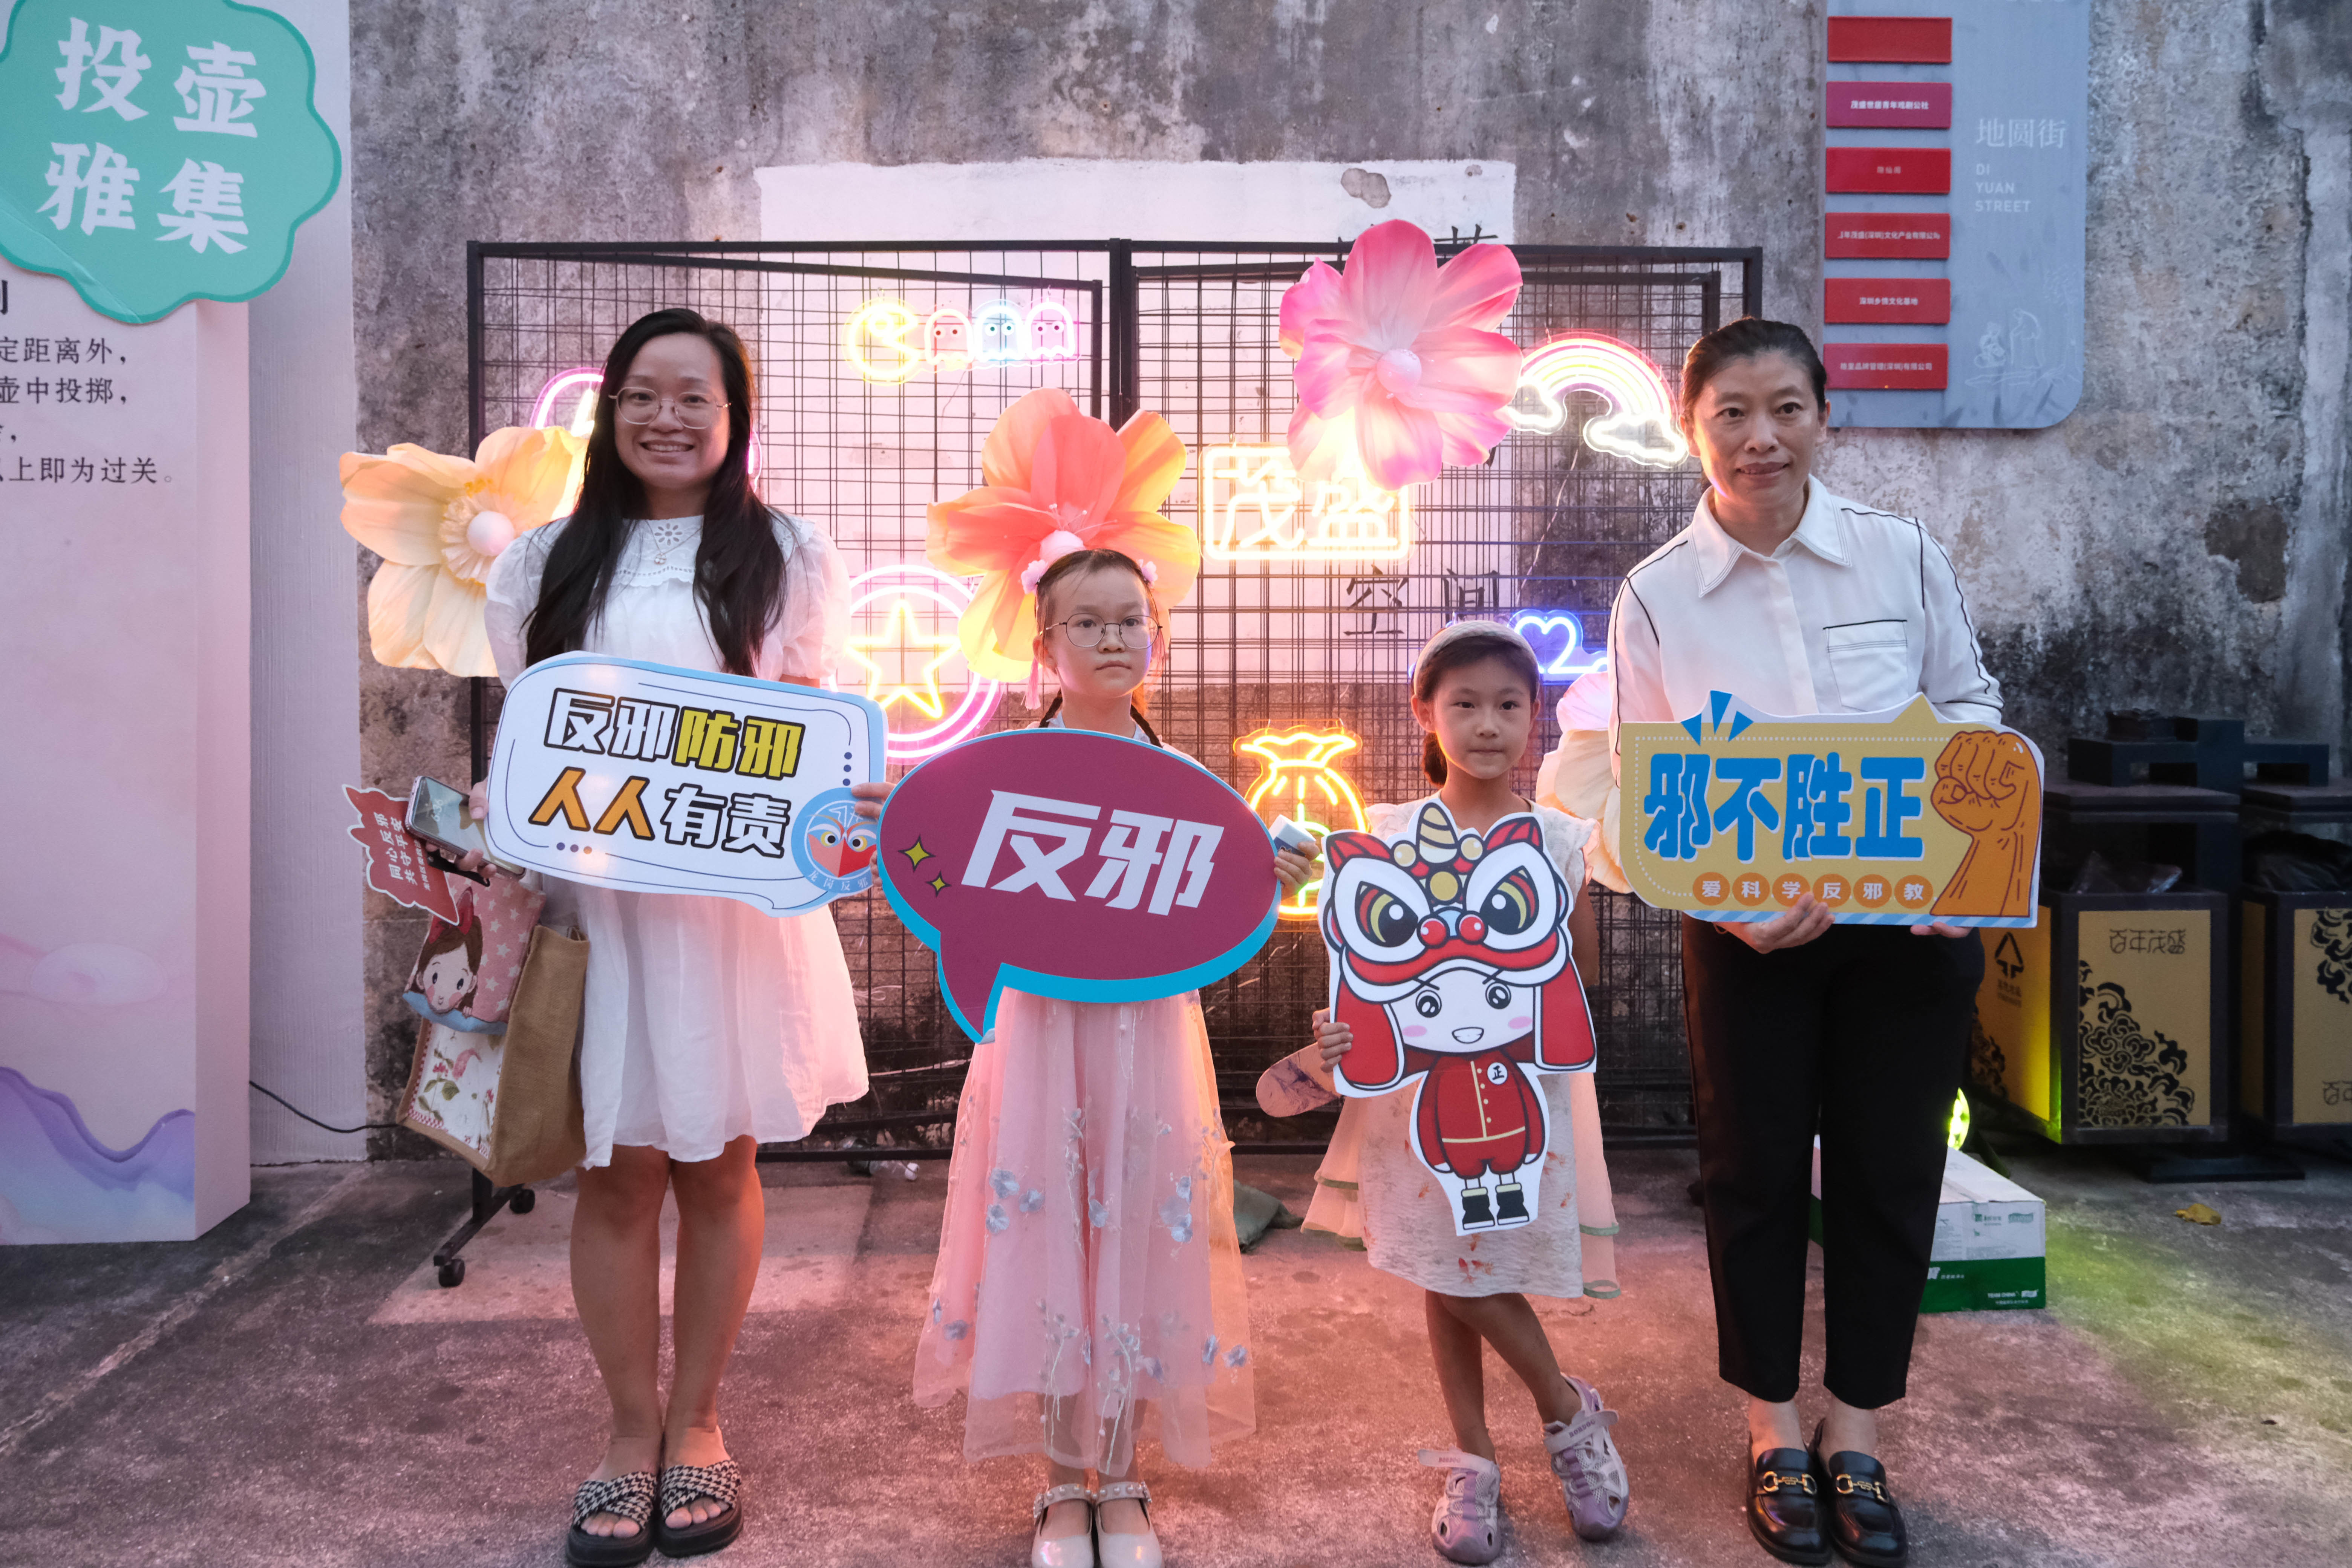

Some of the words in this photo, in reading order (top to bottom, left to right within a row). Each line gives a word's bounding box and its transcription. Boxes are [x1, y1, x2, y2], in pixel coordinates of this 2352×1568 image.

[55, 17, 266, 138] 投壶
[1976, 118, 2066, 148] 地圆街
[1976, 164, 1990, 175] DI
[35, 142, 249, 254] 雅集
[1976, 182, 2014, 193] YUAN
[1975, 200, 2031, 212] STREET
[0, 337, 126, 364] 定距离外，
[0, 376, 126, 404] 壶中投掷，
[0, 456, 172, 484] 上即为过关。
[544, 688, 805, 780] 反邪防邪
[528, 766, 790, 858] 人人有责
[1644, 752, 1925, 863] 邪不胜正
[374, 812, 404, 880] 同心反邪
[391, 817, 418, 886] 共守平安
[961, 789, 1225, 916] 反邪
[1702, 880, 1923, 901] 爱科学反邪教
[1492, 1065, 1504, 1080] 正
